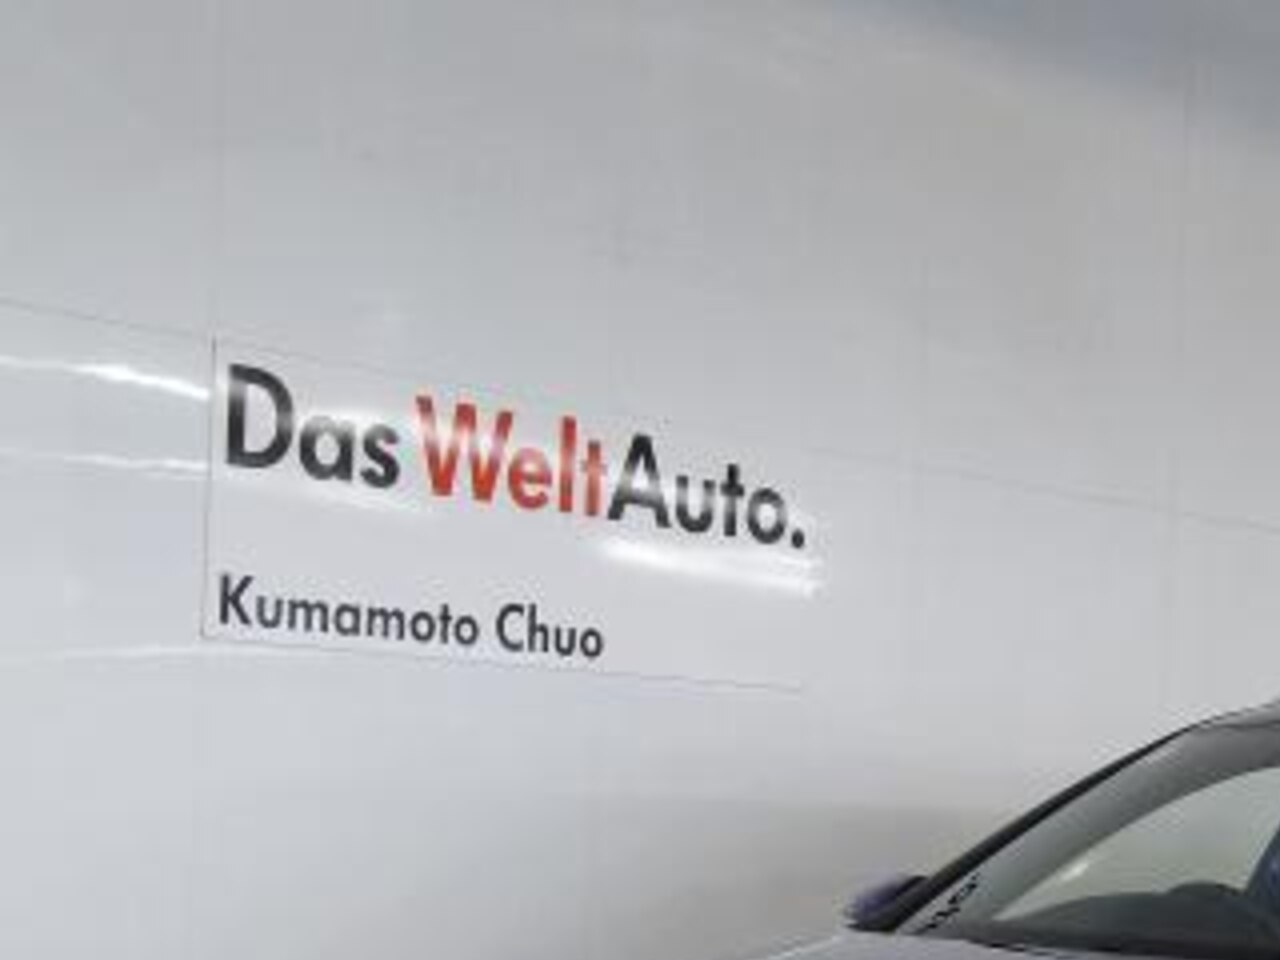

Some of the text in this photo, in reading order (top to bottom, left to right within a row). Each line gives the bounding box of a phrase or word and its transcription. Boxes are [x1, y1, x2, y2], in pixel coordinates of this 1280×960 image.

[224, 363, 807, 549] Das WeltAuto.
[218, 572, 605, 660] Kumamoto Chuo
